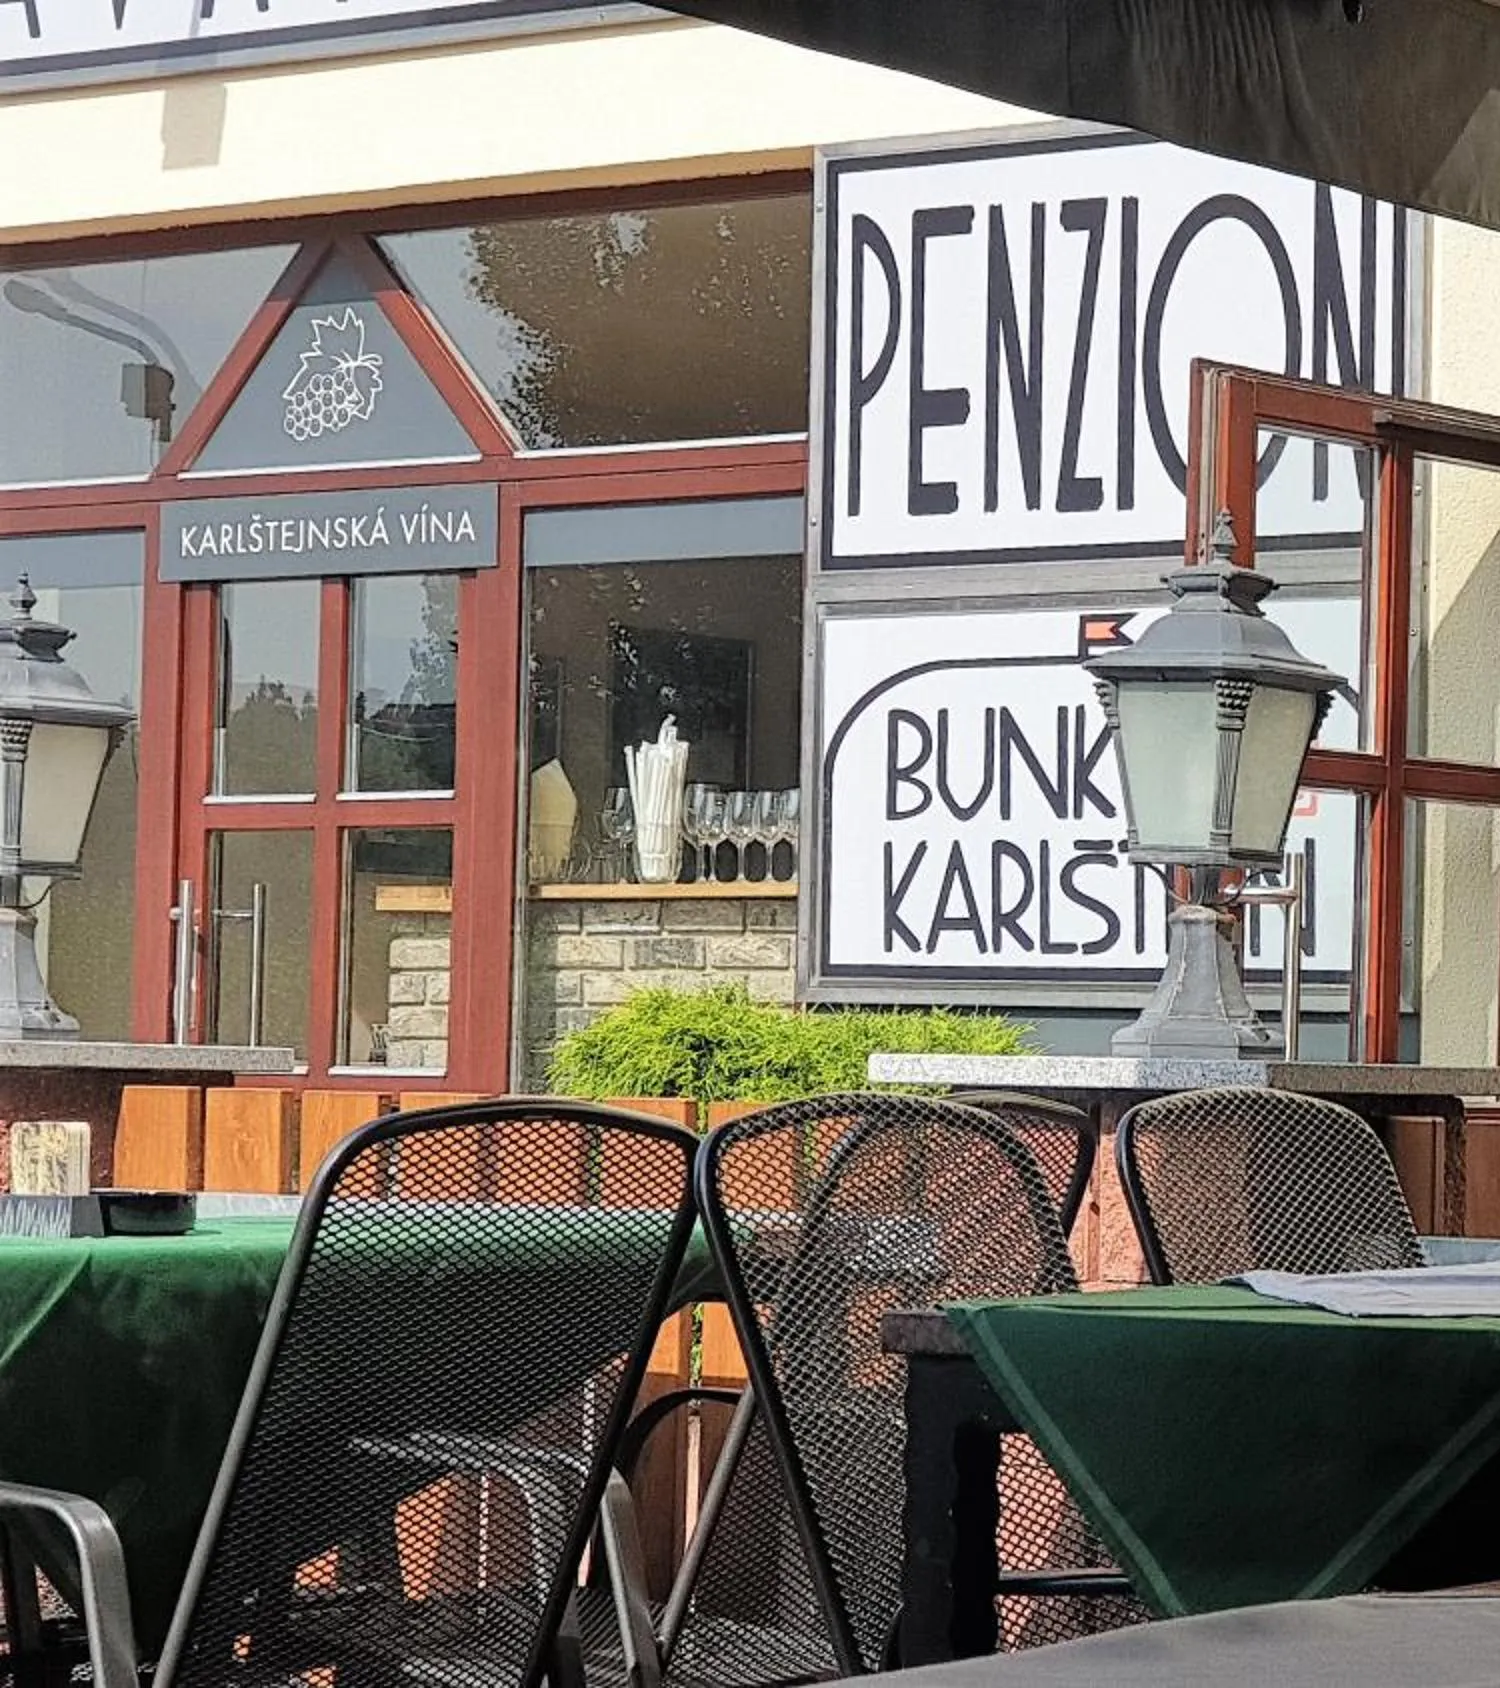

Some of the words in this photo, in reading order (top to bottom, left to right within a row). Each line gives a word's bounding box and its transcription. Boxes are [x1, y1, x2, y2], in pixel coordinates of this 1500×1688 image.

[848, 182, 1375, 516] PENZION
[180, 507, 390, 557] KARLŠTEJNSKÁ
[400, 504, 476, 545] VÍNA
[885, 705, 1117, 822] BUNK
[883, 838, 1316, 957] KARLŠTN
